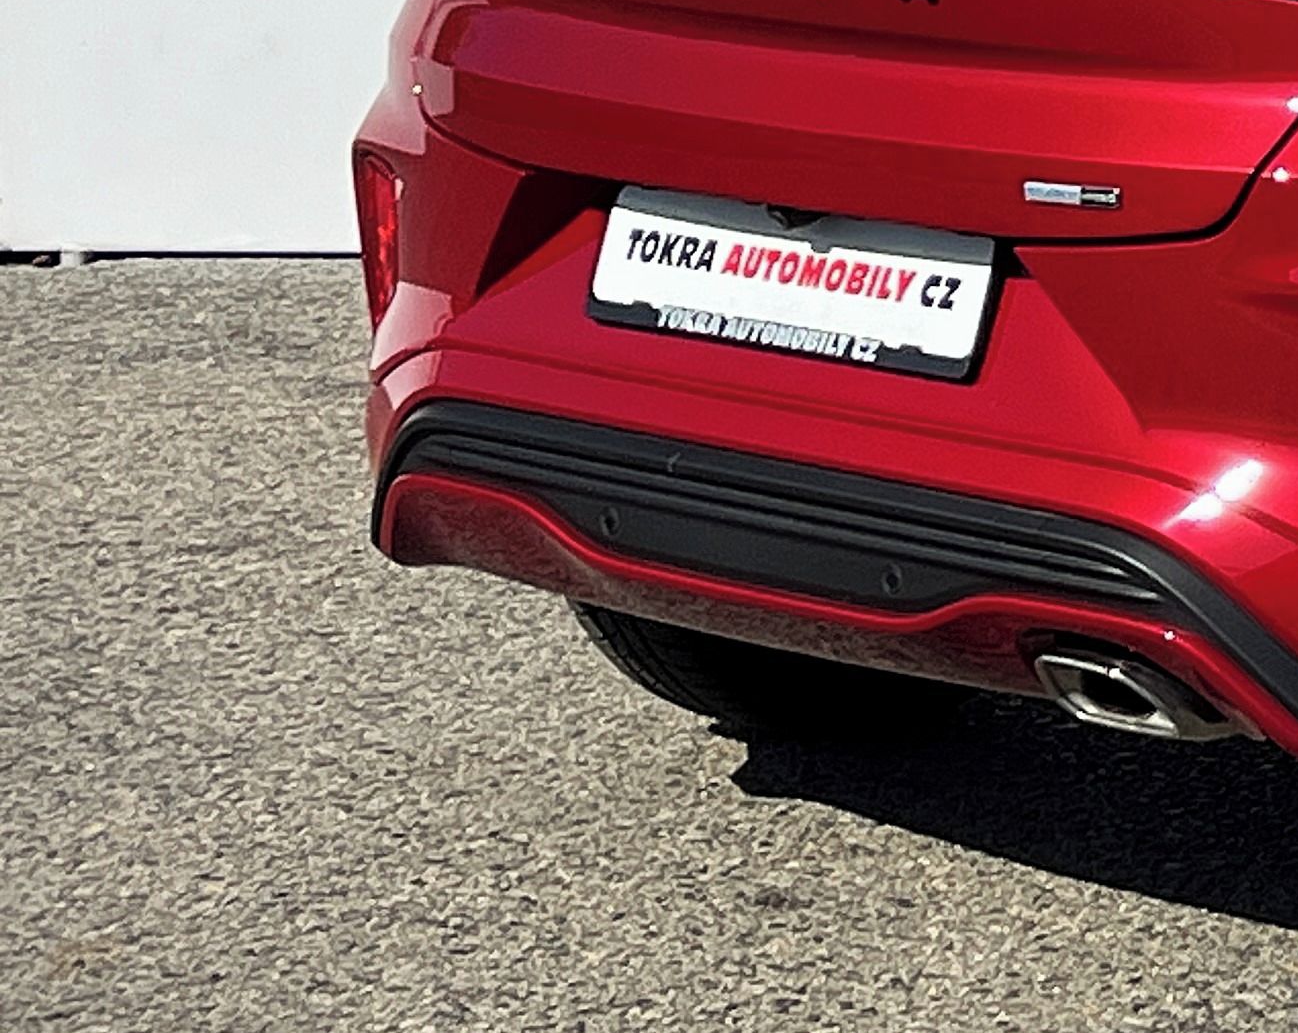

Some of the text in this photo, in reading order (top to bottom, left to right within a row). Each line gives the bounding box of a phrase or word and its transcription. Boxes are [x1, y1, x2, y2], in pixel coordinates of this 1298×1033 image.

[626, 228, 962, 310] TOKRA AUTOMOBILY CZ
[656, 305, 883, 363] TOKRA AUTOMOBILY CZ
